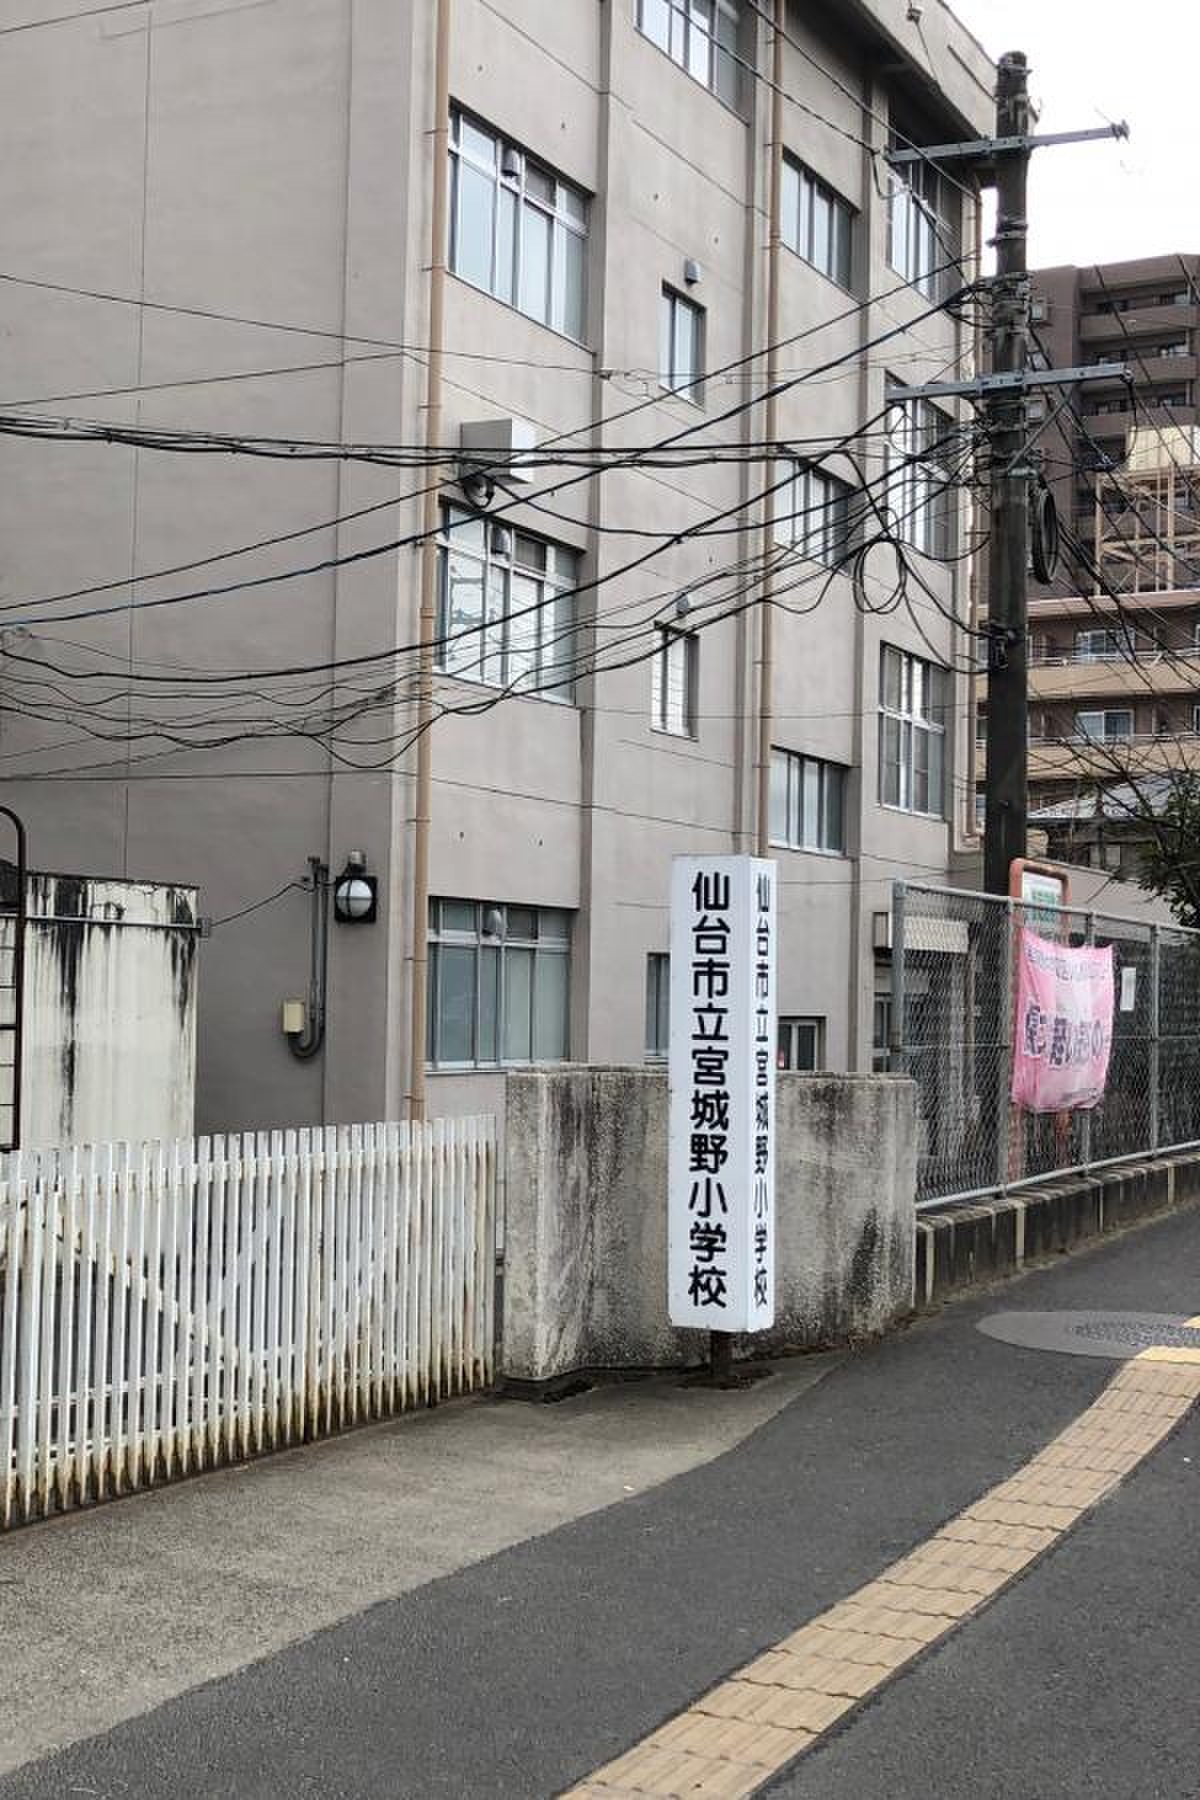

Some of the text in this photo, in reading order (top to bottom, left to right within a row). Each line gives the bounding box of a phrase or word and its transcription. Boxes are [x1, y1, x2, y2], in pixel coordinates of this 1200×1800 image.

[688, 872, 730, 1308] 仙台市立宮城野小学校
[754, 873, 770, 1309] 仙台市立宮城野小学校
